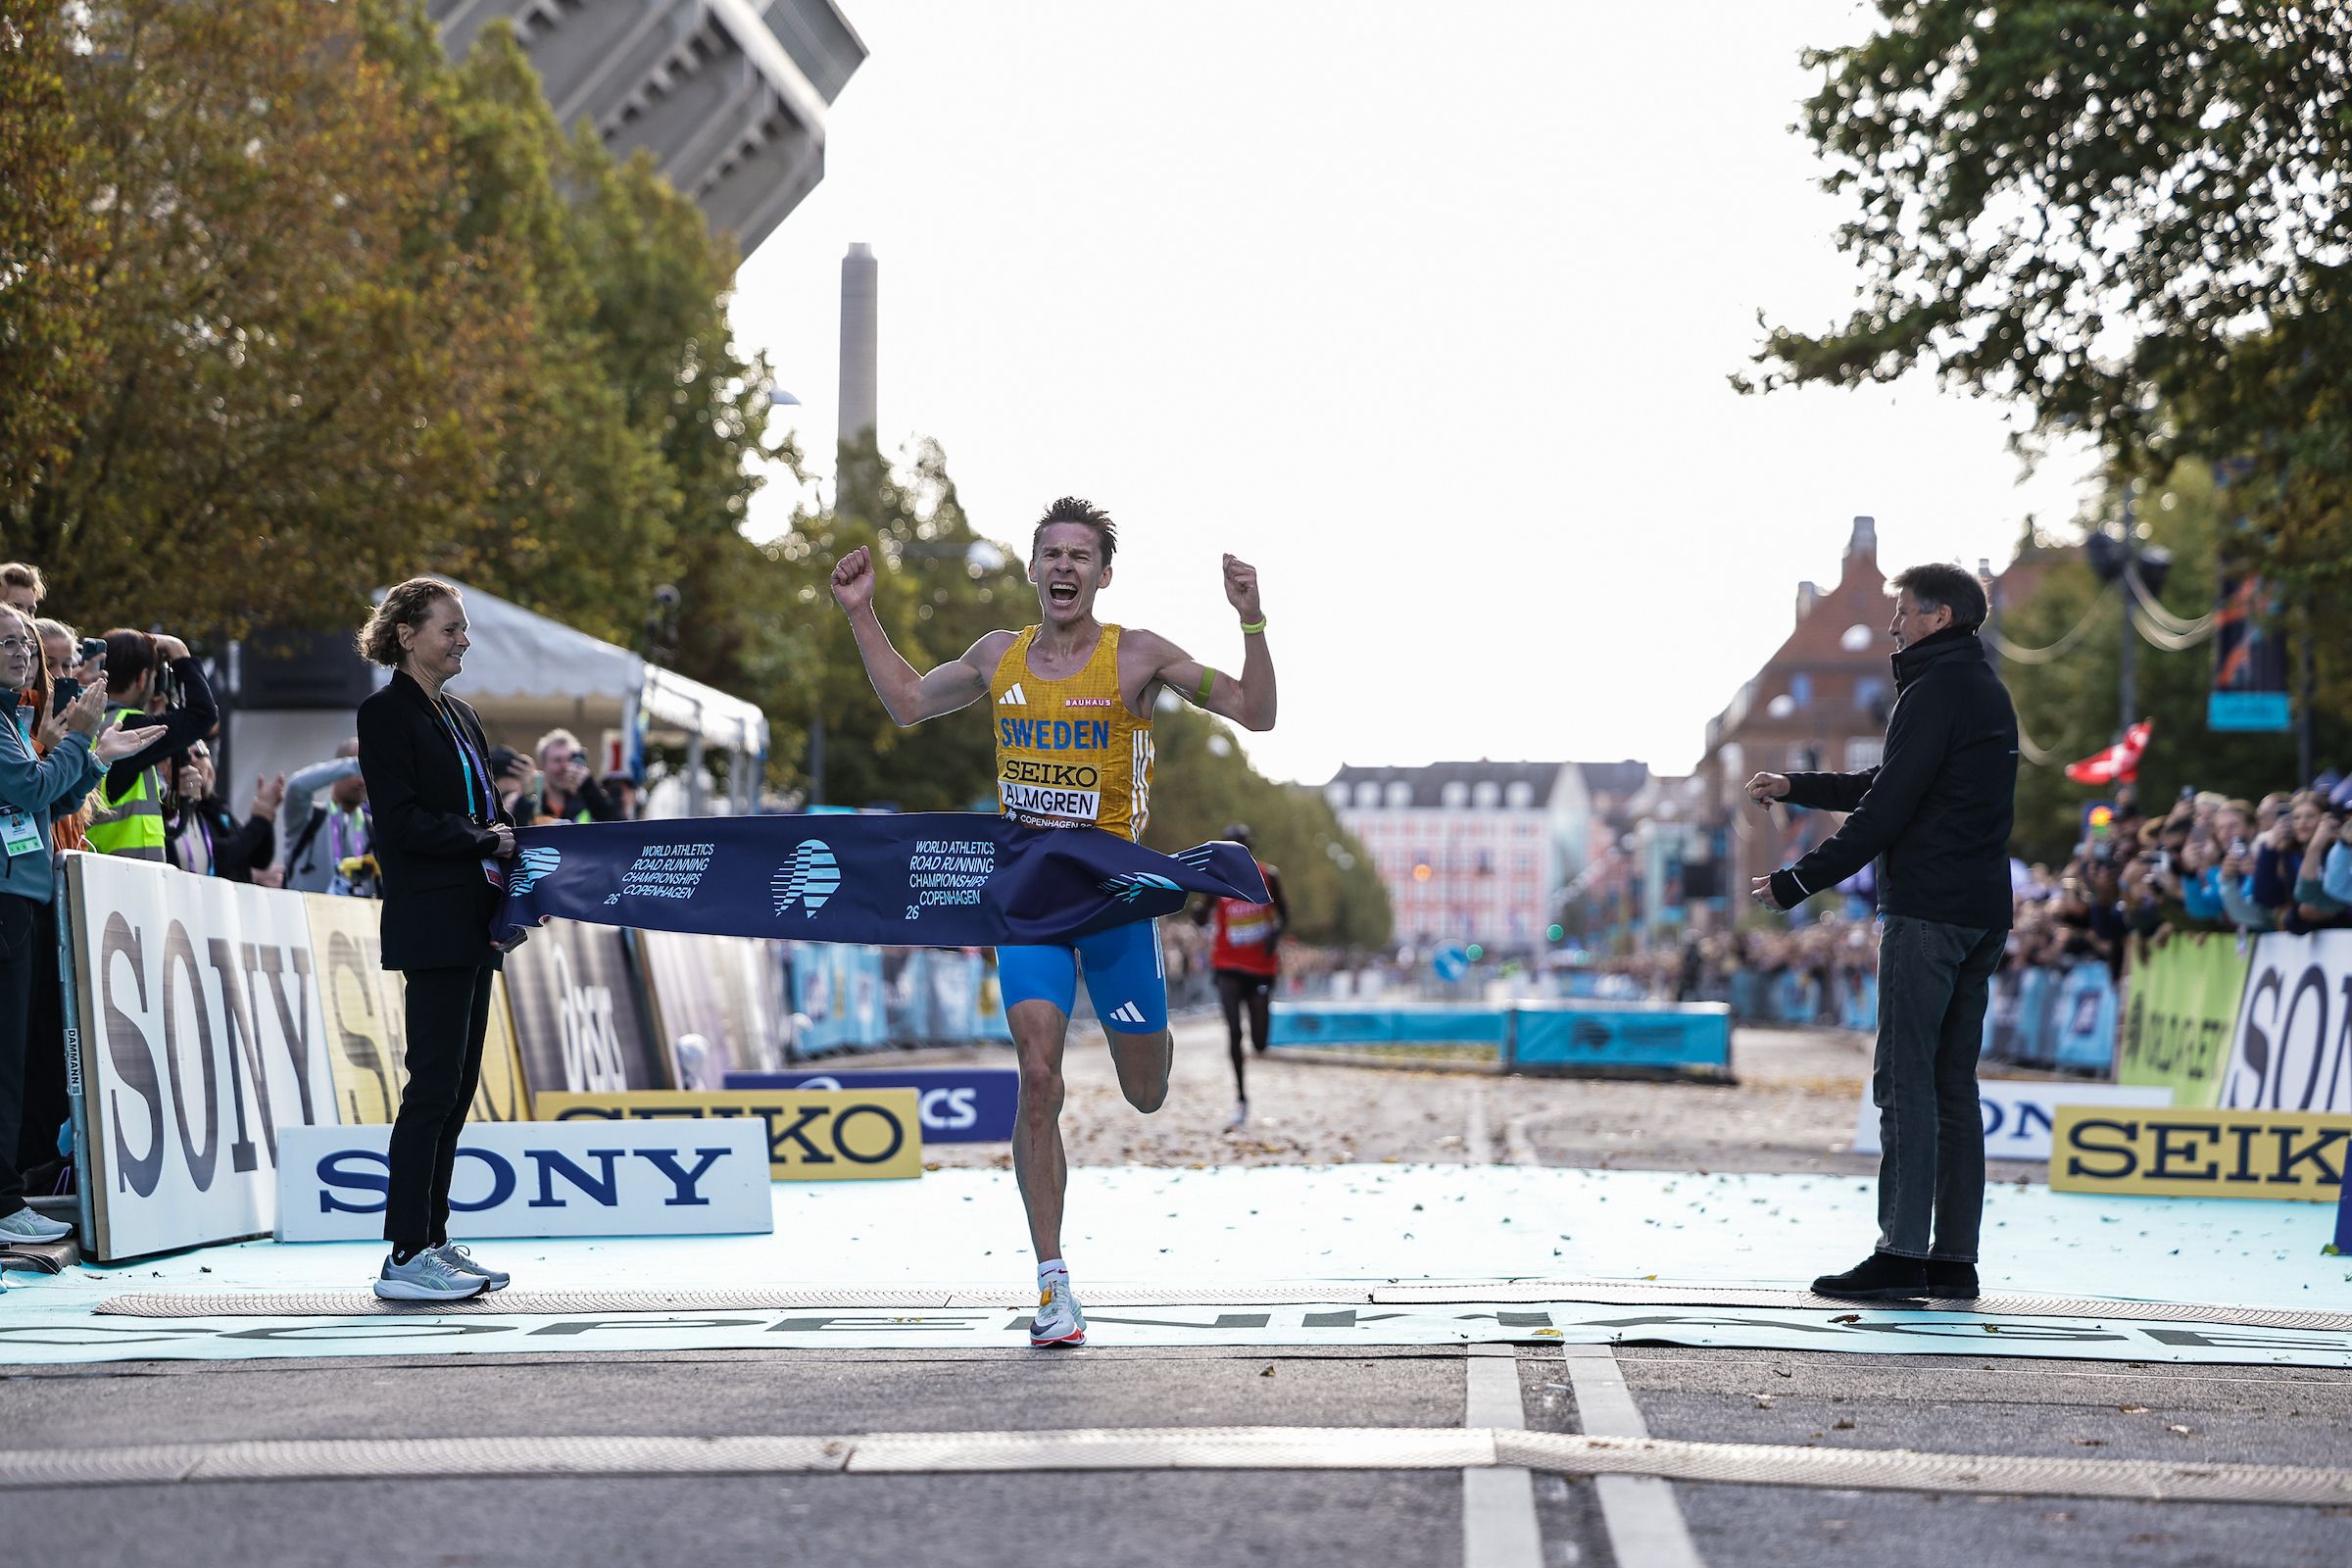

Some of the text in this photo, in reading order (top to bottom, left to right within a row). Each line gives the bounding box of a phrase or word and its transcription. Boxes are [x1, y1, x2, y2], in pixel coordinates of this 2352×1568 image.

[1001, 717, 1109, 750] SWEDEN
[1003, 760, 1098, 788] SEIKO
[1004, 784, 1094, 815] ALMGREN
[1020, 814, 1079, 829] COPENHAGEN
[642, 843, 714, 858] WORLD ATHLETICS
[915, 840, 996, 855] WORLD ATHLETICS
[630, 858, 710, 871] ROAD RUNNING
[909, 856, 995, 873] ROAD RUNNING
[621, 871, 703, 885] CHAMPIONSHIPS
[909, 873, 988, 888] CHAMPIONSHIPS
[603, 893, 621, 905] 26
[622, 884, 696, 900] COPENHAGEN
[919, 889, 981, 906] COPENHAGEN
[905, 905, 920, 920] 26
[68, 1030, 79, 1085] DAMMANN
[102, 911, 315, 1198] SONY
[317, 1147, 732, 1214] SONY
